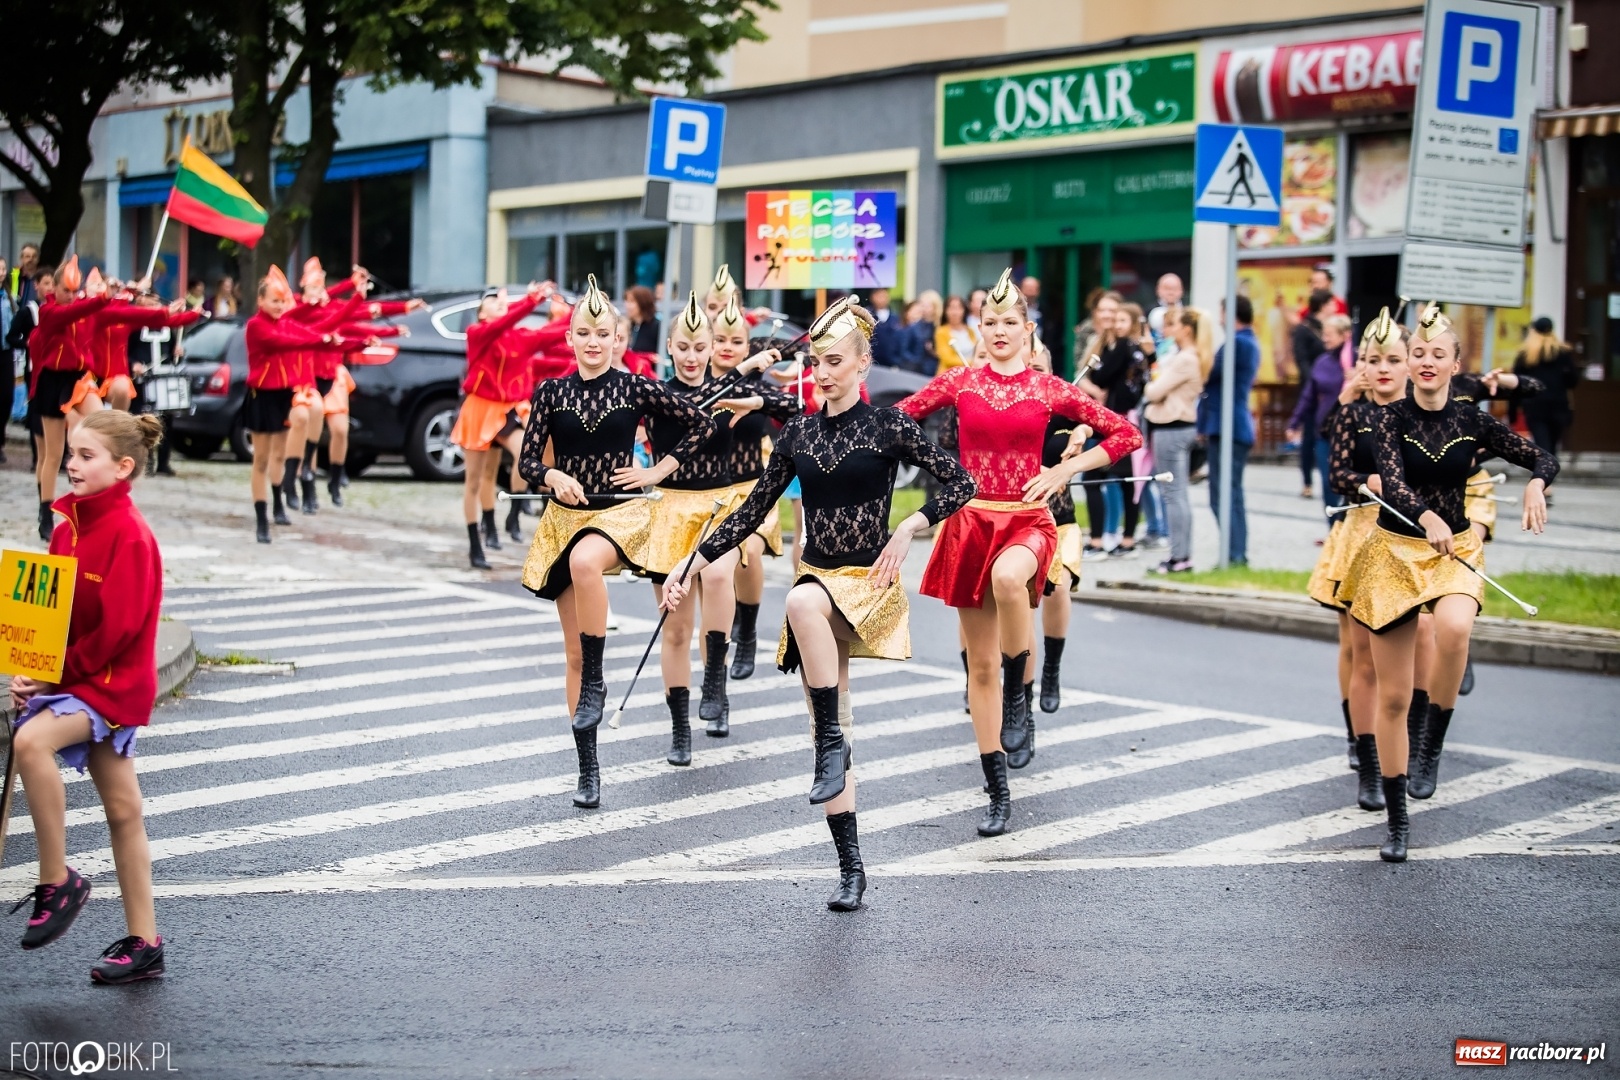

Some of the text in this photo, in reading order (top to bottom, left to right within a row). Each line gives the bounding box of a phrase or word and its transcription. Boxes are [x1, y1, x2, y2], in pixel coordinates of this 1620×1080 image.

[1455, 25, 1503, 102] P
[994, 67, 1136, 132] OSKAR
[664, 108, 709, 170] P
[767, 198, 877, 218] TĘCZA
[757, 221, 886, 240] RACIBÓRZ
[782, 248, 859, 262] POLSKA
[13, 560, 60, 609] ZARA
[0, 624, 36, 645] POWIAT
[10, 647, 57, 672] RACIBÓRZ
